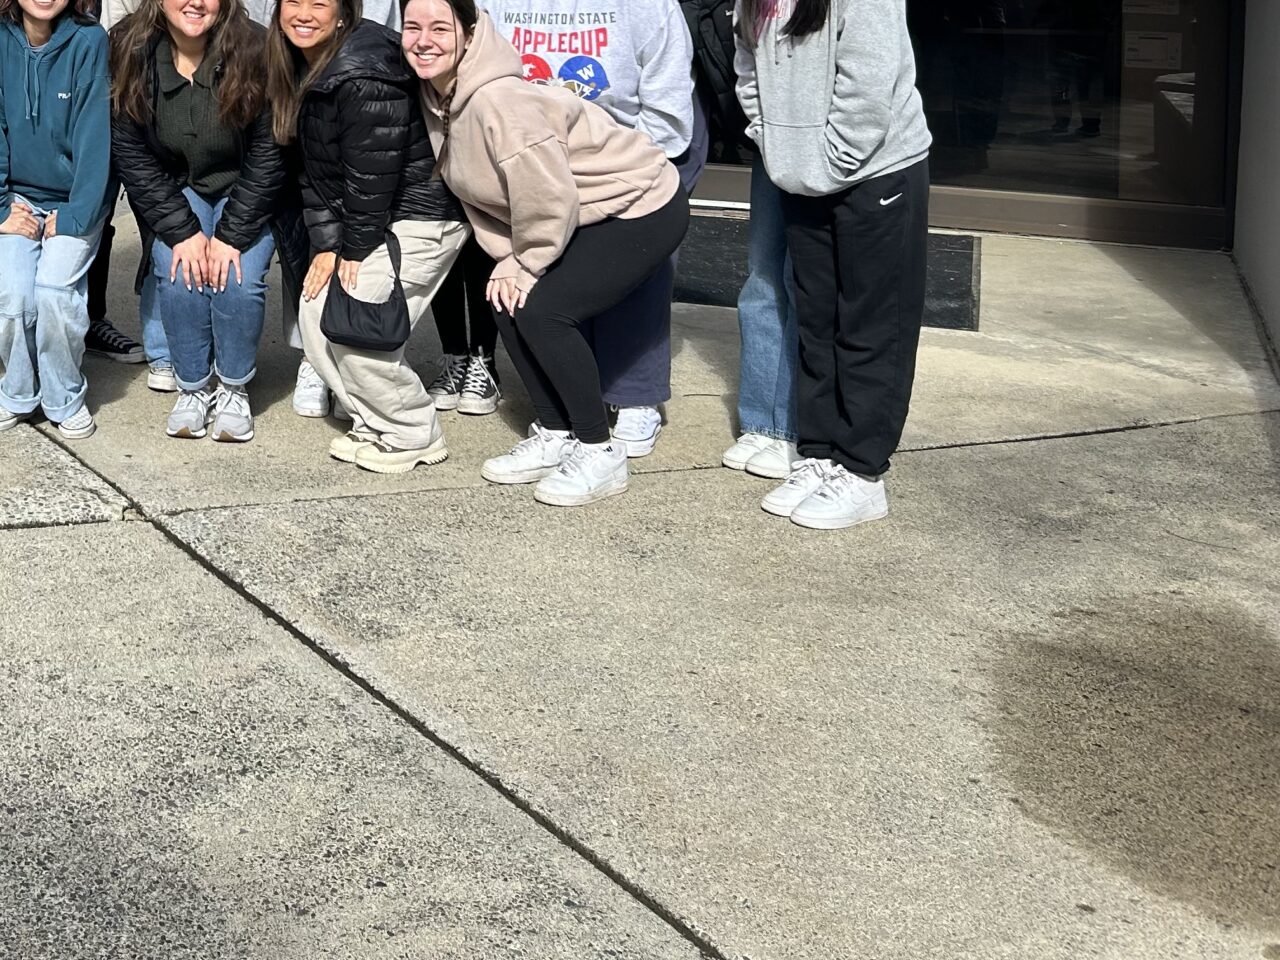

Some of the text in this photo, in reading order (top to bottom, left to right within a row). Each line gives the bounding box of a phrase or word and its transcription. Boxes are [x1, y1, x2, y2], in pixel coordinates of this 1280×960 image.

[504, 11, 617, 25] WASHINGTON STATE
[512, 26, 608, 58] APPLECUP
[576, 63, 595, 81] W
